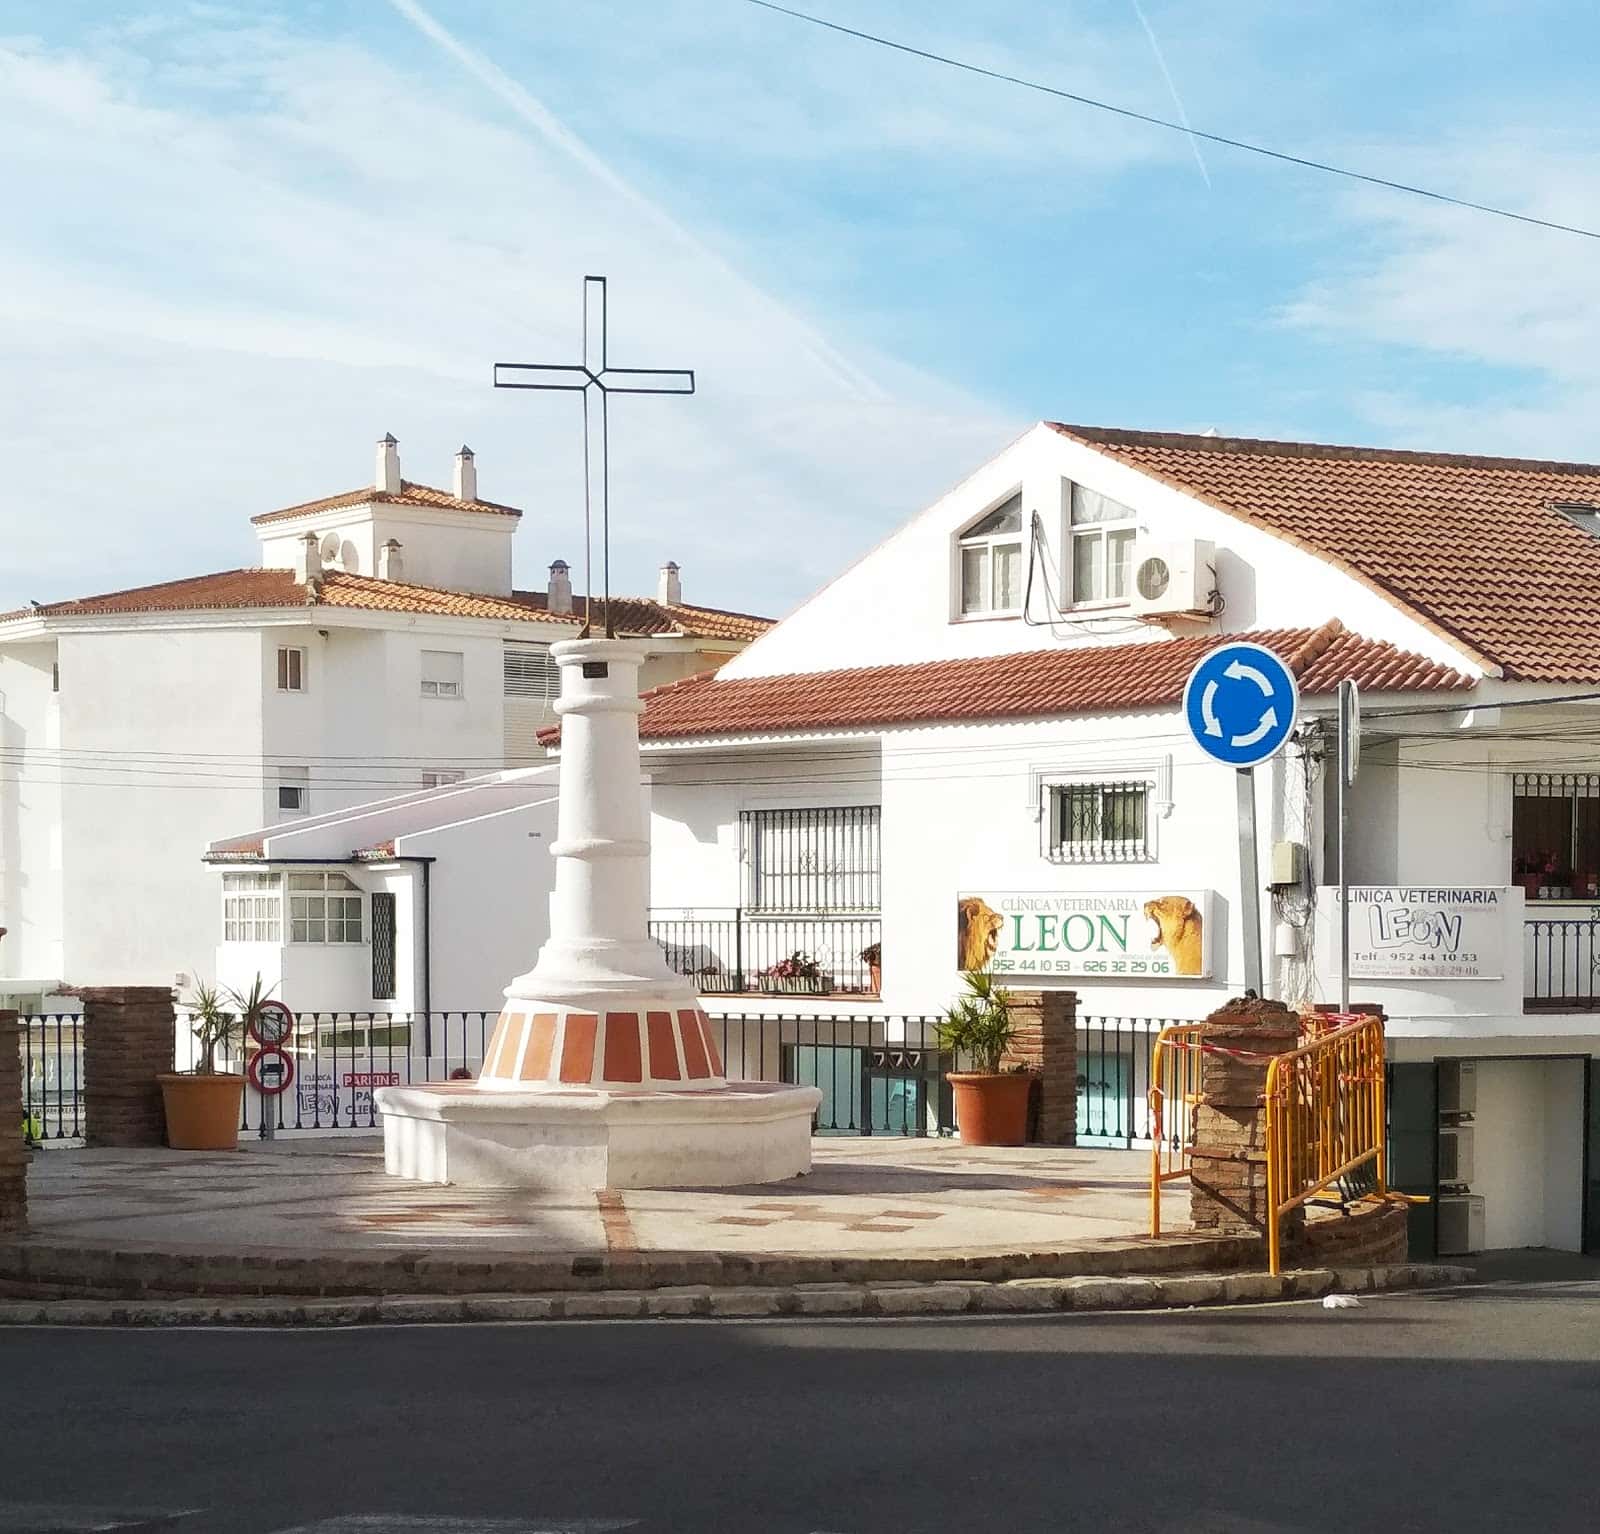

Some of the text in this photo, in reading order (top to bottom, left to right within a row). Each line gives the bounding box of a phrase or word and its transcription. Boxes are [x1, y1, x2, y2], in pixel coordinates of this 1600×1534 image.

[1001, 896, 1138, 911] CLÍNICA VETERINARIA
[1400, 890, 1498, 904] VETERINARIA
[1010, 914, 1131, 952] LEON
[1368, 903, 1462, 953] LEON
[1390, 952, 1415, 961] 952
[1419, 952, 1435, 961] 44
[1442, 953, 1457, 961] 10
[1460, 953, 1477, 962] 53
[993, 959, 1169, 973] 952 44 10 53 626 32 29 06
[344, 1075, 399, 1086] PARKING
[356, 1091, 374, 1101] PA
[345, 1104, 378, 1115] CLIEN
